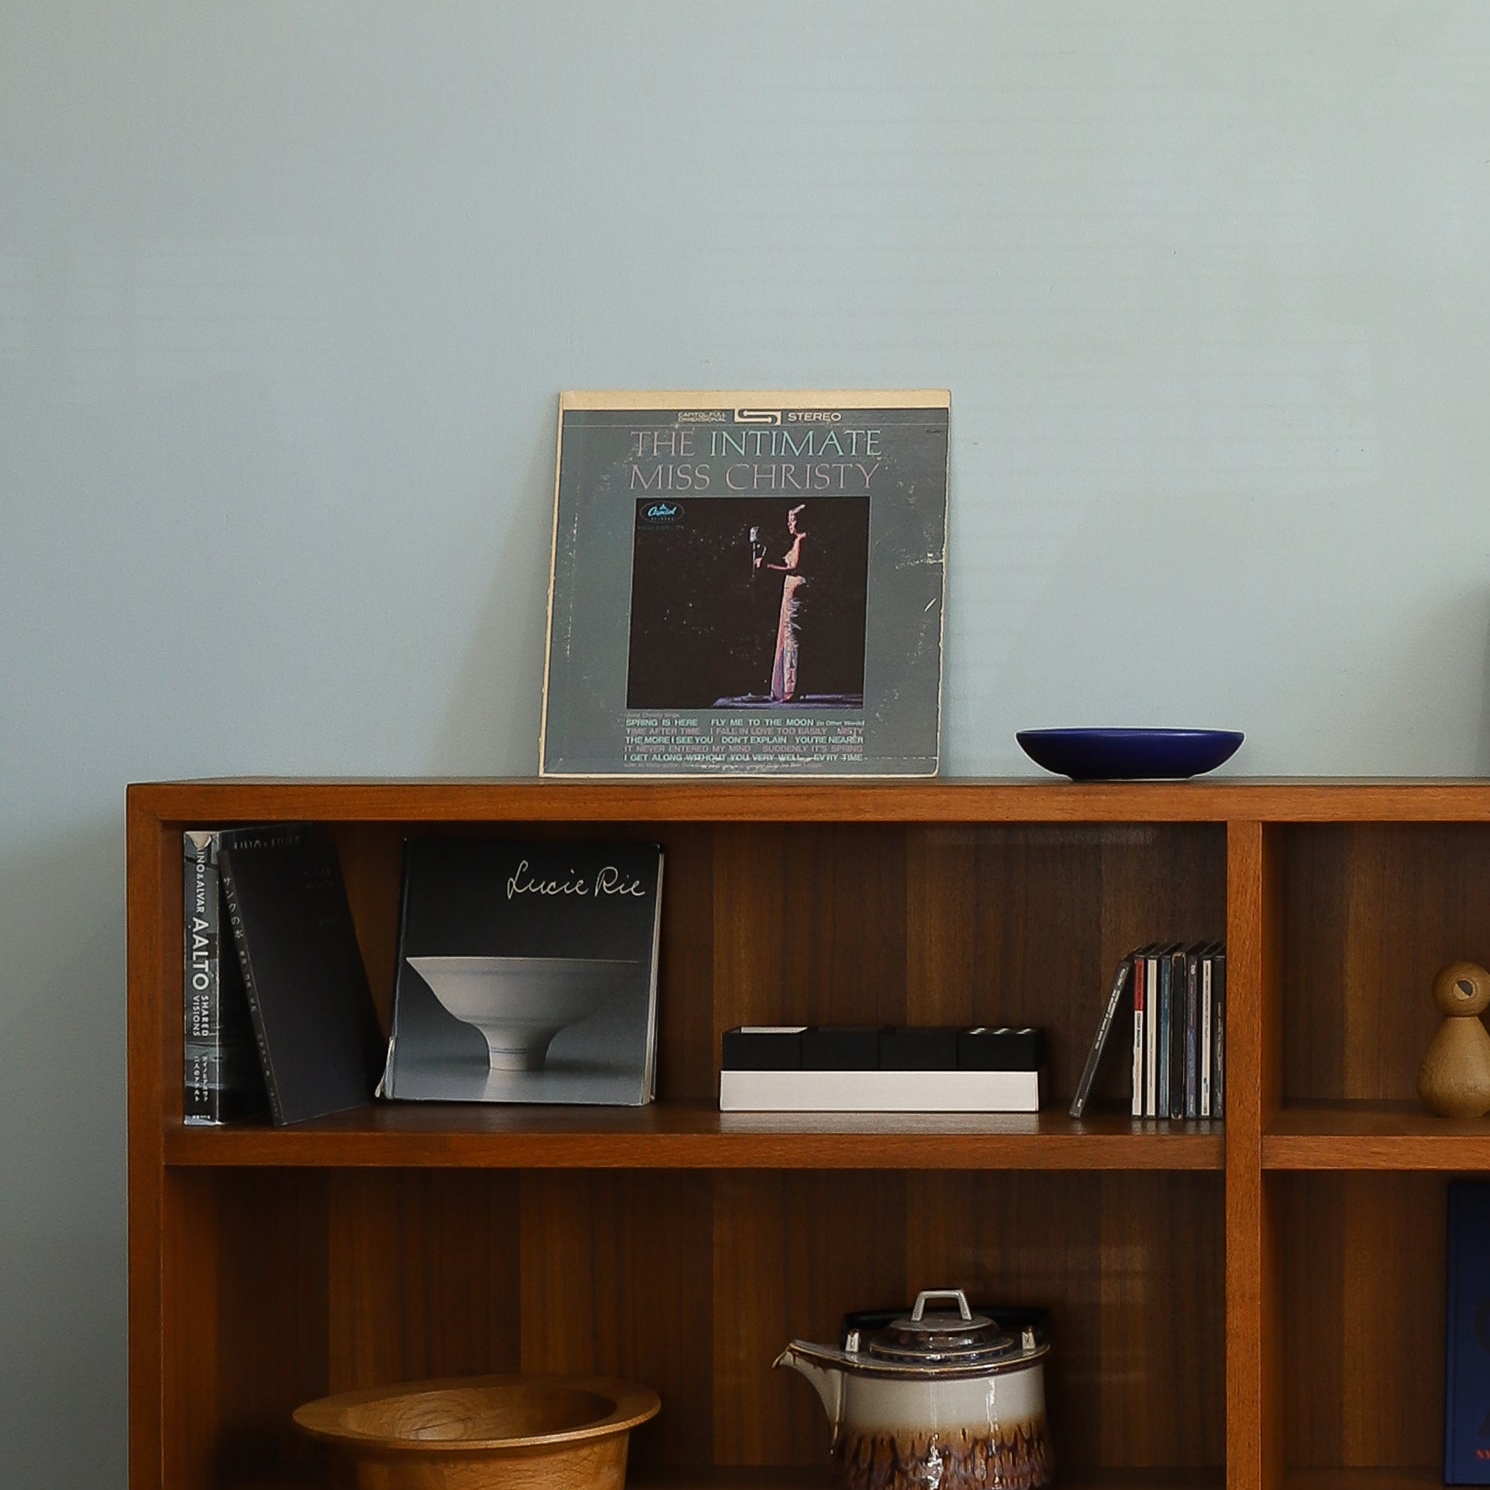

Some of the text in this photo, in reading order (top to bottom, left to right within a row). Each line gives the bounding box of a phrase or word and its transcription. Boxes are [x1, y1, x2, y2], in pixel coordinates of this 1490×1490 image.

[788, 412, 842, 422] STEREO
[631, 429, 882, 457] THE INTIMATE
[629, 461, 881, 491] MISS CHRISTY
[626, 718, 658, 727] SPRING
[662, 718, 671, 727] IS
[674, 718, 698, 727] HERE
[710, 718, 726, 727] FLY
[730, 718, 743, 727] ME
[748, 718, 760, 727] TO
[765, 718, 782, 727] THE
[785, 718, 814, 727] MOON
[626, 736, 643, 744] THE
[644, 736, 669, 744] MORE
[676, 736, 693, 744] SEE
[695, 736, 713, 744] YOU
[750, 736, 787, 744] EXPLAIN
[828, 736, 864, 744] NEARER
[630, 753, 648, 761] GET
[652, 753, 683, 761] ALONG
[753, 753, 774, 761] VERY
[506, 860, 646, 900] Lucie Rie
[191, 916, 209, 991] AALTO
[192, 994, 201, 1037] VISIONS
[200, 995, 209, 1037] SHARED
